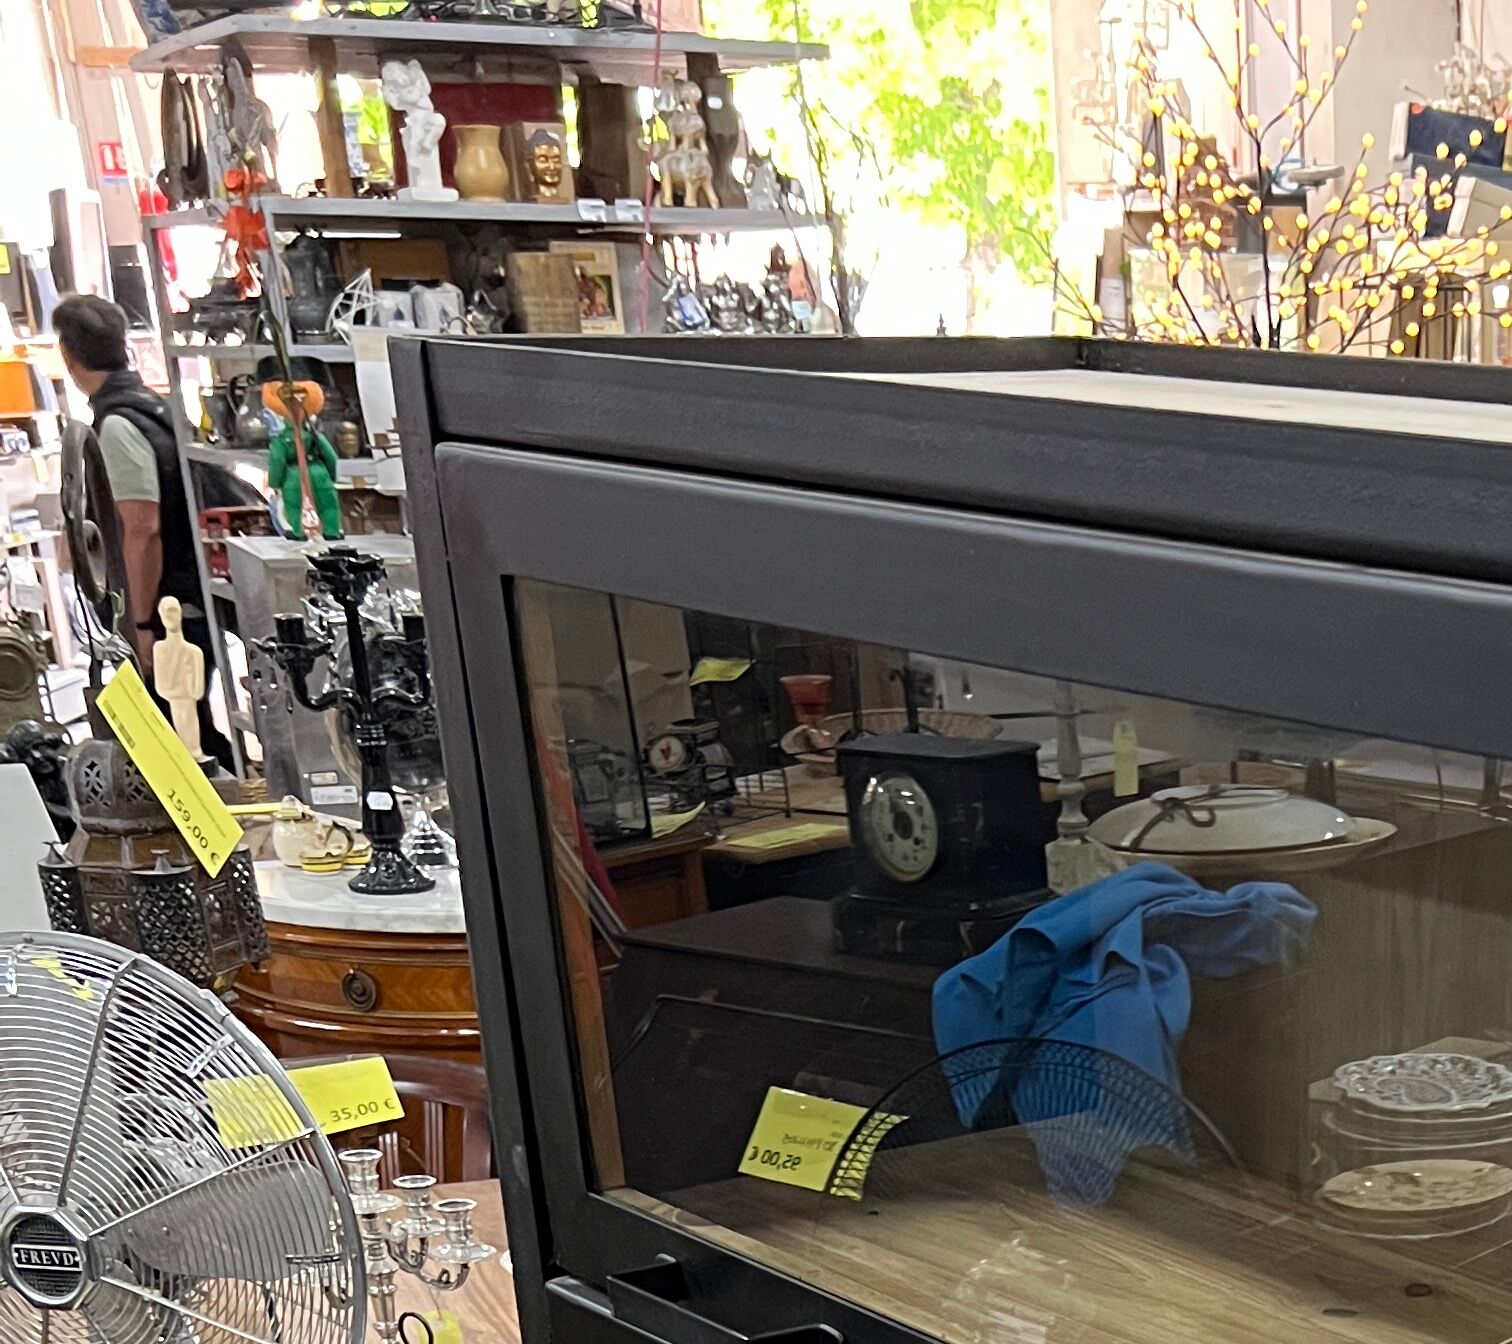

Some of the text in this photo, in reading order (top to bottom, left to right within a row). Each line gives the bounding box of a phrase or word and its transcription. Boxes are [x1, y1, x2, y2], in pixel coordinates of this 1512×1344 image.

[166, 787, 221, 866] 159,00 €
[331, 1097, 396, 1122] 35,00 €
